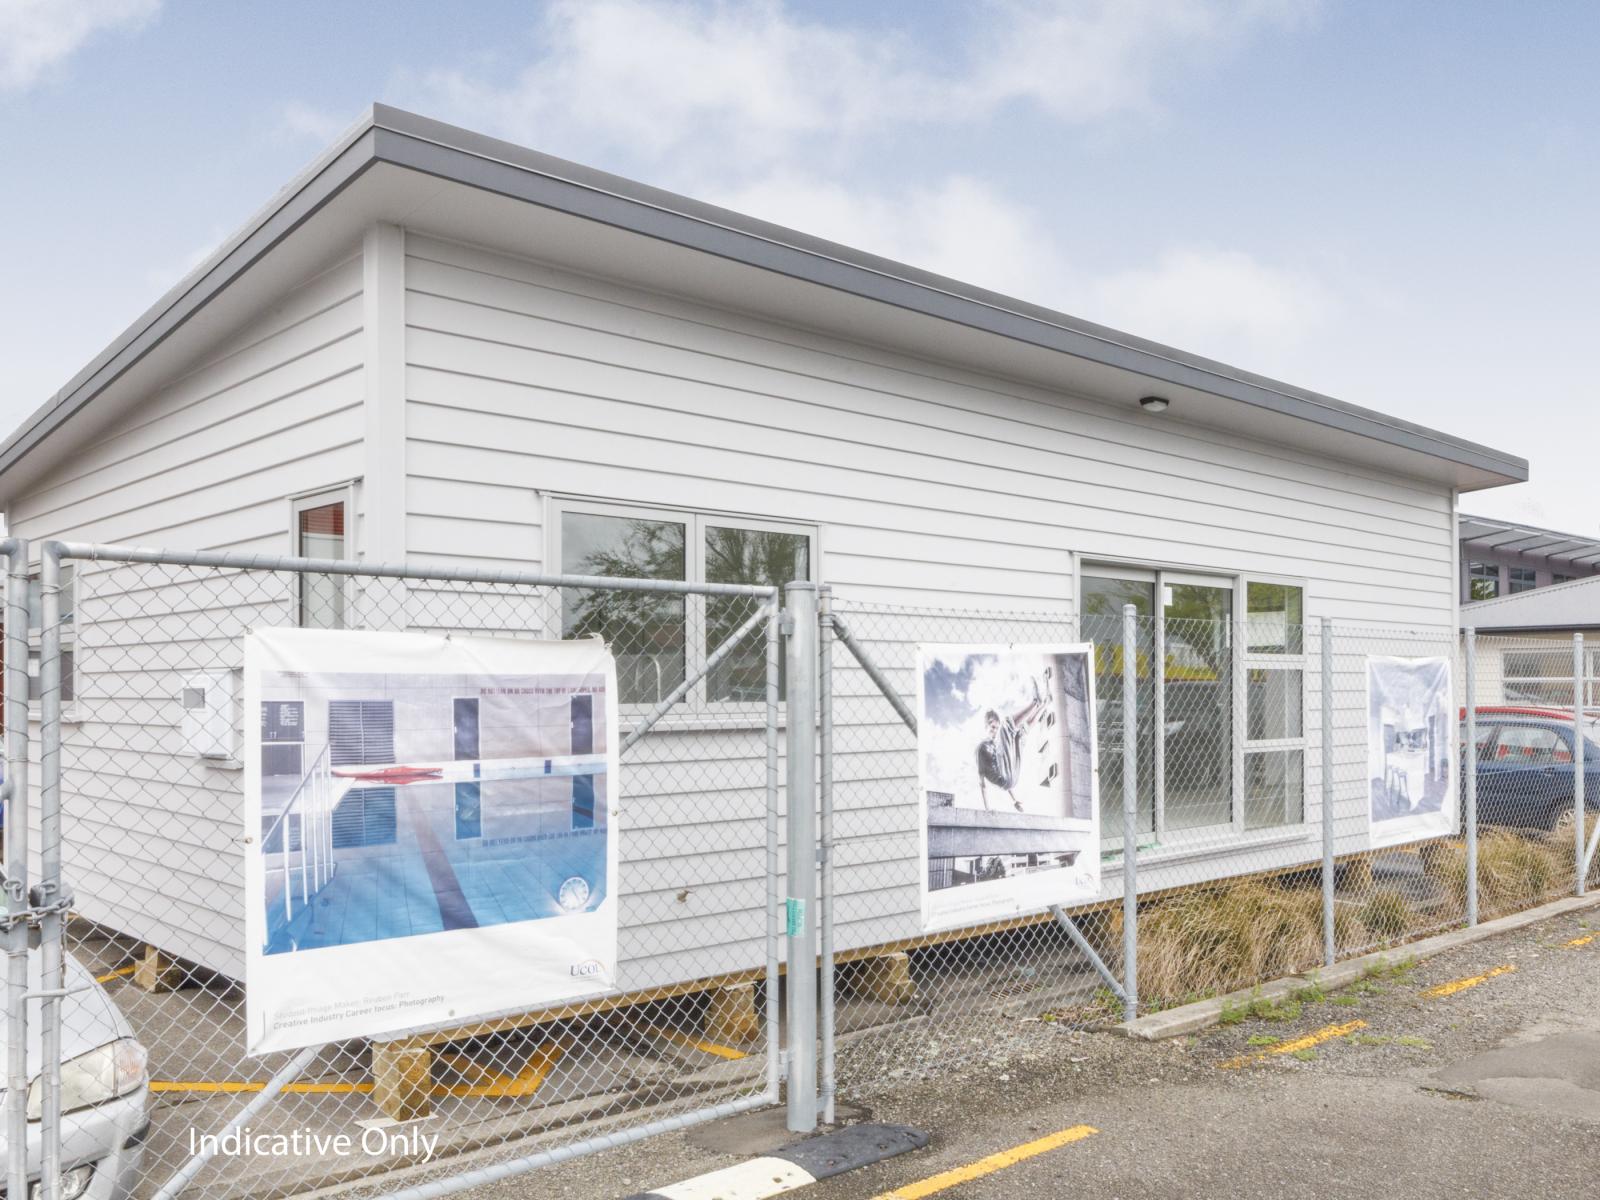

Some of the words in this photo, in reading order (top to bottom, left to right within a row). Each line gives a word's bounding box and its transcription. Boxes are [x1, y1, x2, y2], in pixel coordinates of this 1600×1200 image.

[273, 1018, 309, 1030] Creative
[310, 1011, 344, 1023] Industry
[345, 1006, 373, 1018] Career
[399, 995, 445, 1009] Photography
